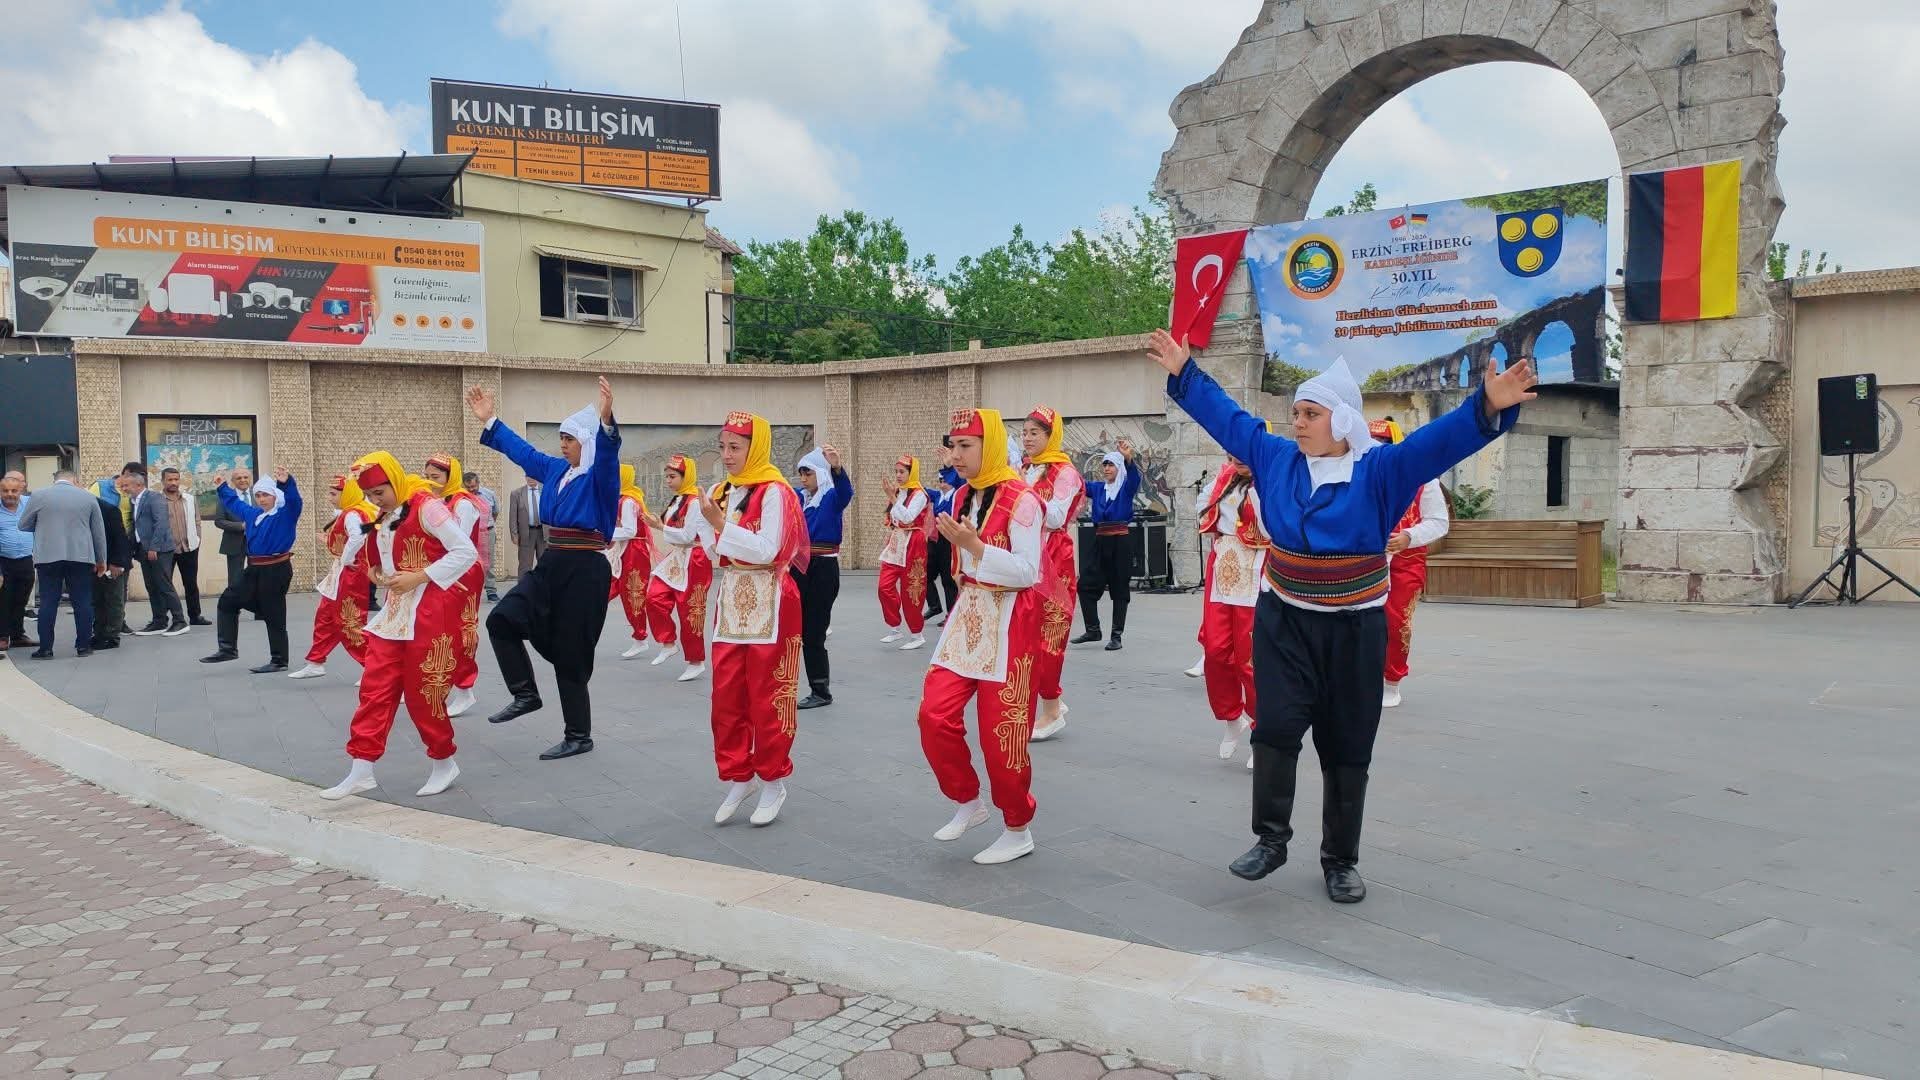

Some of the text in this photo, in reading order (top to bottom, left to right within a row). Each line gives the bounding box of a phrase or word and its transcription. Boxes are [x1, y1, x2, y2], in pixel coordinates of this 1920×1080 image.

[451, 98, 655, 139] KUNT BİLİŞİM
[525, 167, 549, 175] TEKNİK
[111, 226, 275, 255] KUNT BİLİŞİM
[1351, 244, 1393, 260] ERZİN
[1402, 235, 1473, 254] FREİBERG
[403, 246, 465, 258] 0540 681 0101
[403, 256, 465, 268] 0540 681 0102
[257, 266, 328, 280] HIKVISION
[1391, 268, 1438, 285] 30.YIL
[1335, 299, 1497, 322] Herzlichen Glückwunsch zum
[1335, 315, 1498, 339] 30 jährigen Jubiläum zwischen
